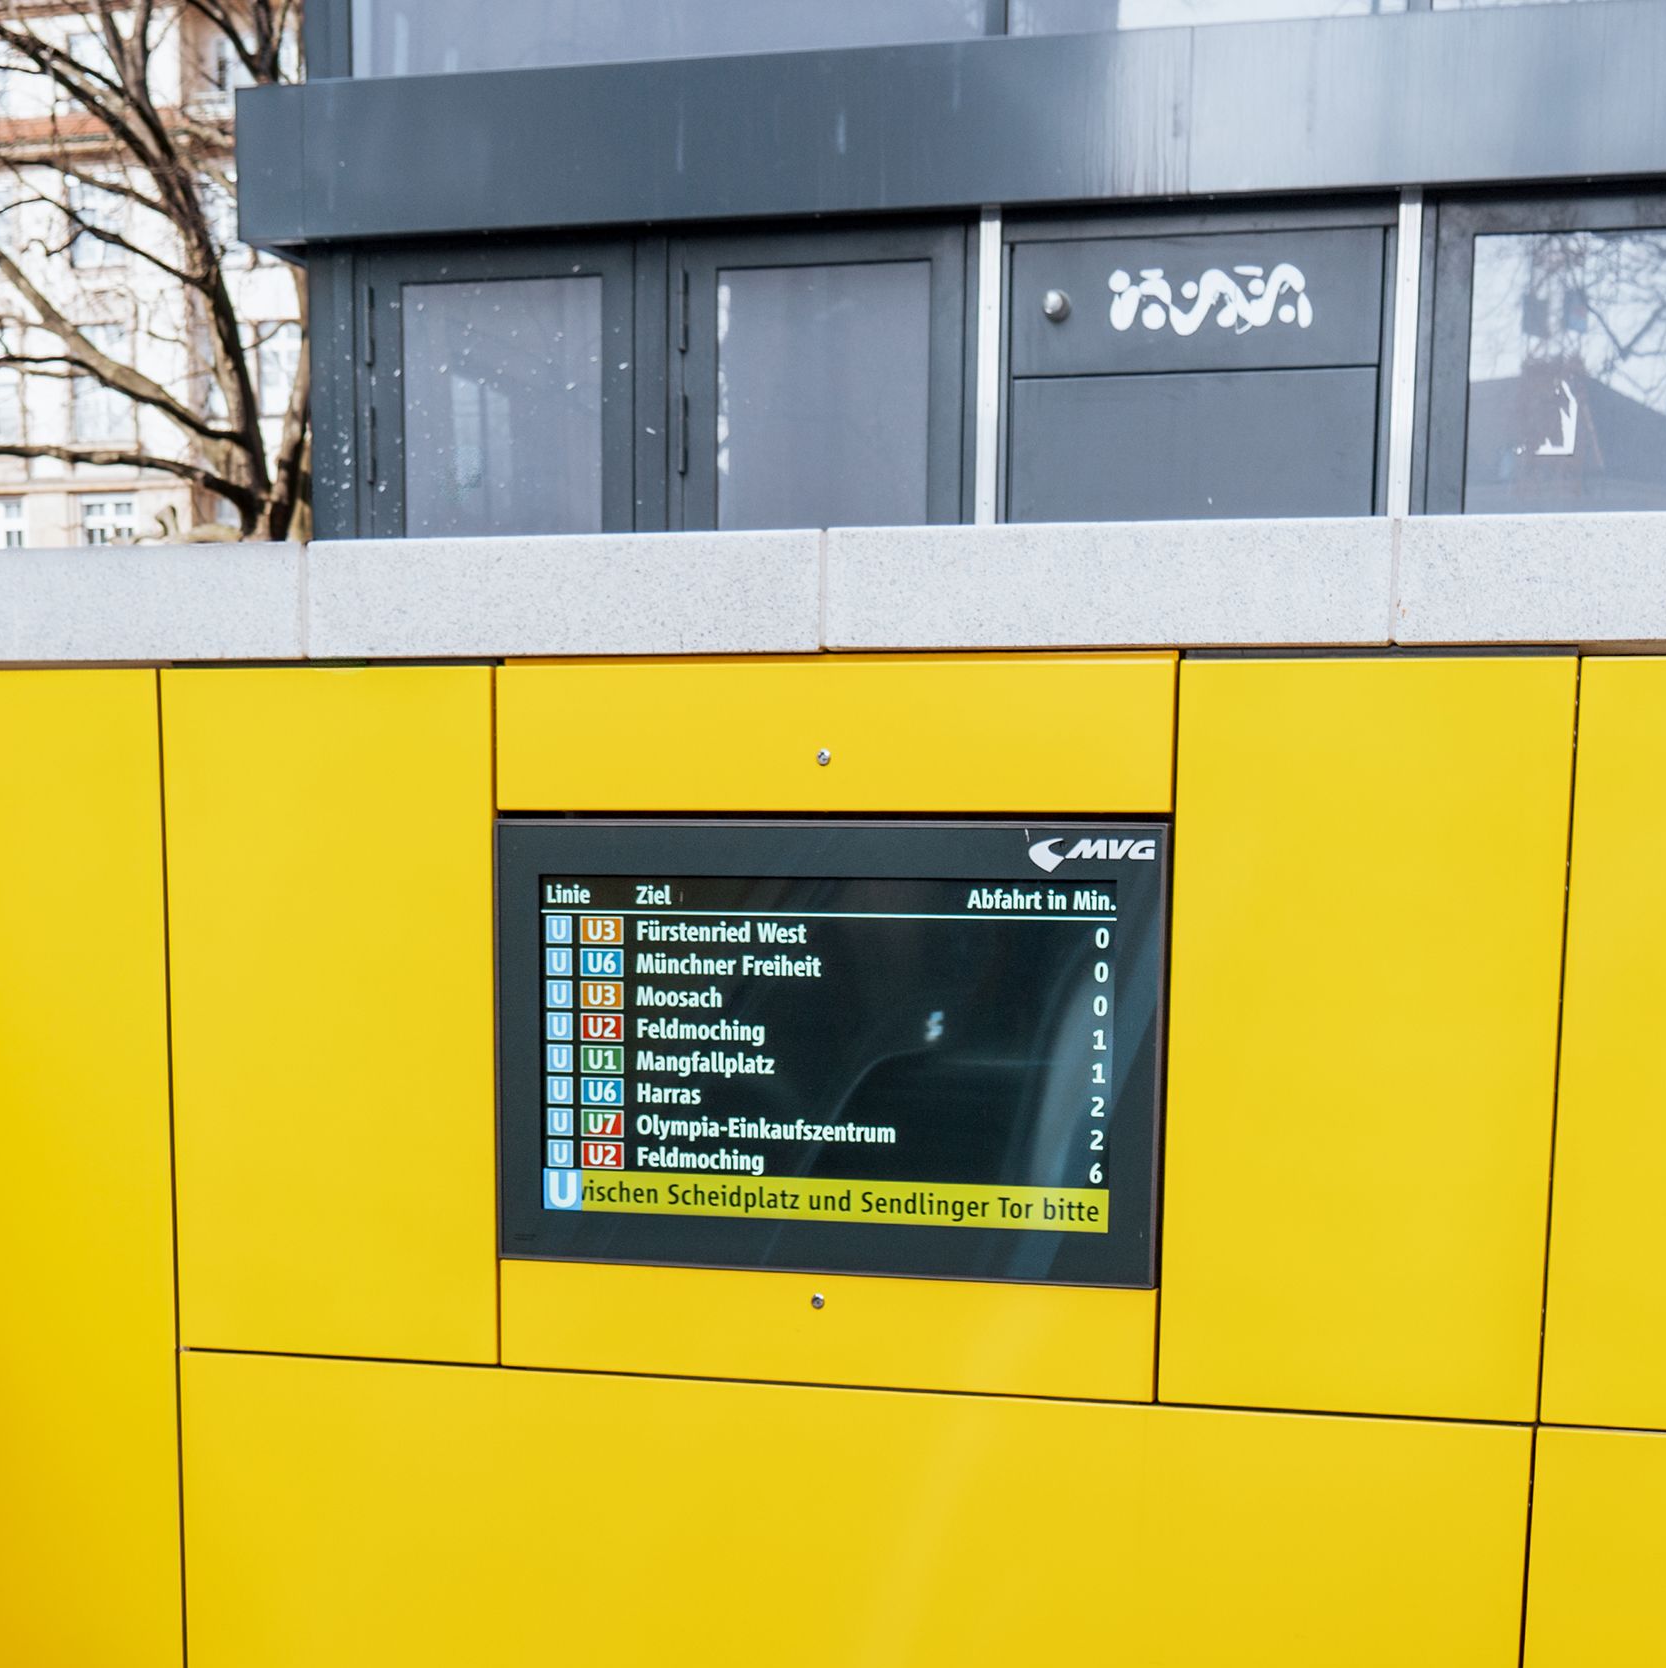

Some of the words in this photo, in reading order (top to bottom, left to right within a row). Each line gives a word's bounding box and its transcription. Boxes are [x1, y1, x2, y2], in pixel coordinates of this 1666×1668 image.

[1064, 835, 1157, 862] MVG
[546, 883, 591, 904] Linie
[635, 884, 672, 905] Ziel
[967, 888, 1043, 911] Abfahrt
[1047, 889, 1067, 911] in
[1073, 889, 1117, 911] Min.
[551, 918, 568, 939] U
[587, 918, 618, 940] U3
[636, 919, 751, 943] Fürstenried
[756, 922, 807, 944] West
[1095, 927, 1110, 949] 0
[551, 950, 568, 971] U
[587, 950, 618, 972] U6
[636, 952, 737, 976] Münchner
[742, 954, 822, 978] Freiheit
[1094, 962, 1109, 983] 0
[551, 982, 568, 1004] U
[587, 982, 618, 1005] U3
[636, 985, 723, 1008] Moosach
[1093, 995, 1108, 1017] 0
[552, 1013, 569, 1036] U
[587, 1014, 618, 1038] U2
[637, 1017, 765, 1045] Feldmoching
[1092, 1029, 1107, 1051] 1
[552, 1046, 569, 1068] U
[587, 1047, 618, 1070] U1
[636, 1050, 775, 1077] Mangfallplatz
[1092, 1063, 1106, 1084] 1
[552, 1079, 569, 1100] U
[587, 1080, 618, 1102] U6
[637, 1082, 702, 1105] Harras
[1090, 1096, 1105, 1118] 2
[553, 1110, 570, 1133] U
[587, 1111, 618, 1135] U7
[636, 1114, 896, 1144] Olympia-Einkaufszentrum
[1090, 1129, 1104, 1151] 2
[553, 1142, 570, 1165] U
[587, 1143, 618, 1167] U2
[637, 1146, 764, 1176] Feldmoching
[1089, 1162, 1103, 1184] 6
[549, 1171, 577, 1208] U
[668, 1184, 800, 1213] Scheidplatz
[809, 1189, 851, 1212] und
[861, 1192, 989, 1222] Sendlinger
[997, 1196, 1033, 1219] Tor
[1044, 1197, 1099, 1222] bitte
